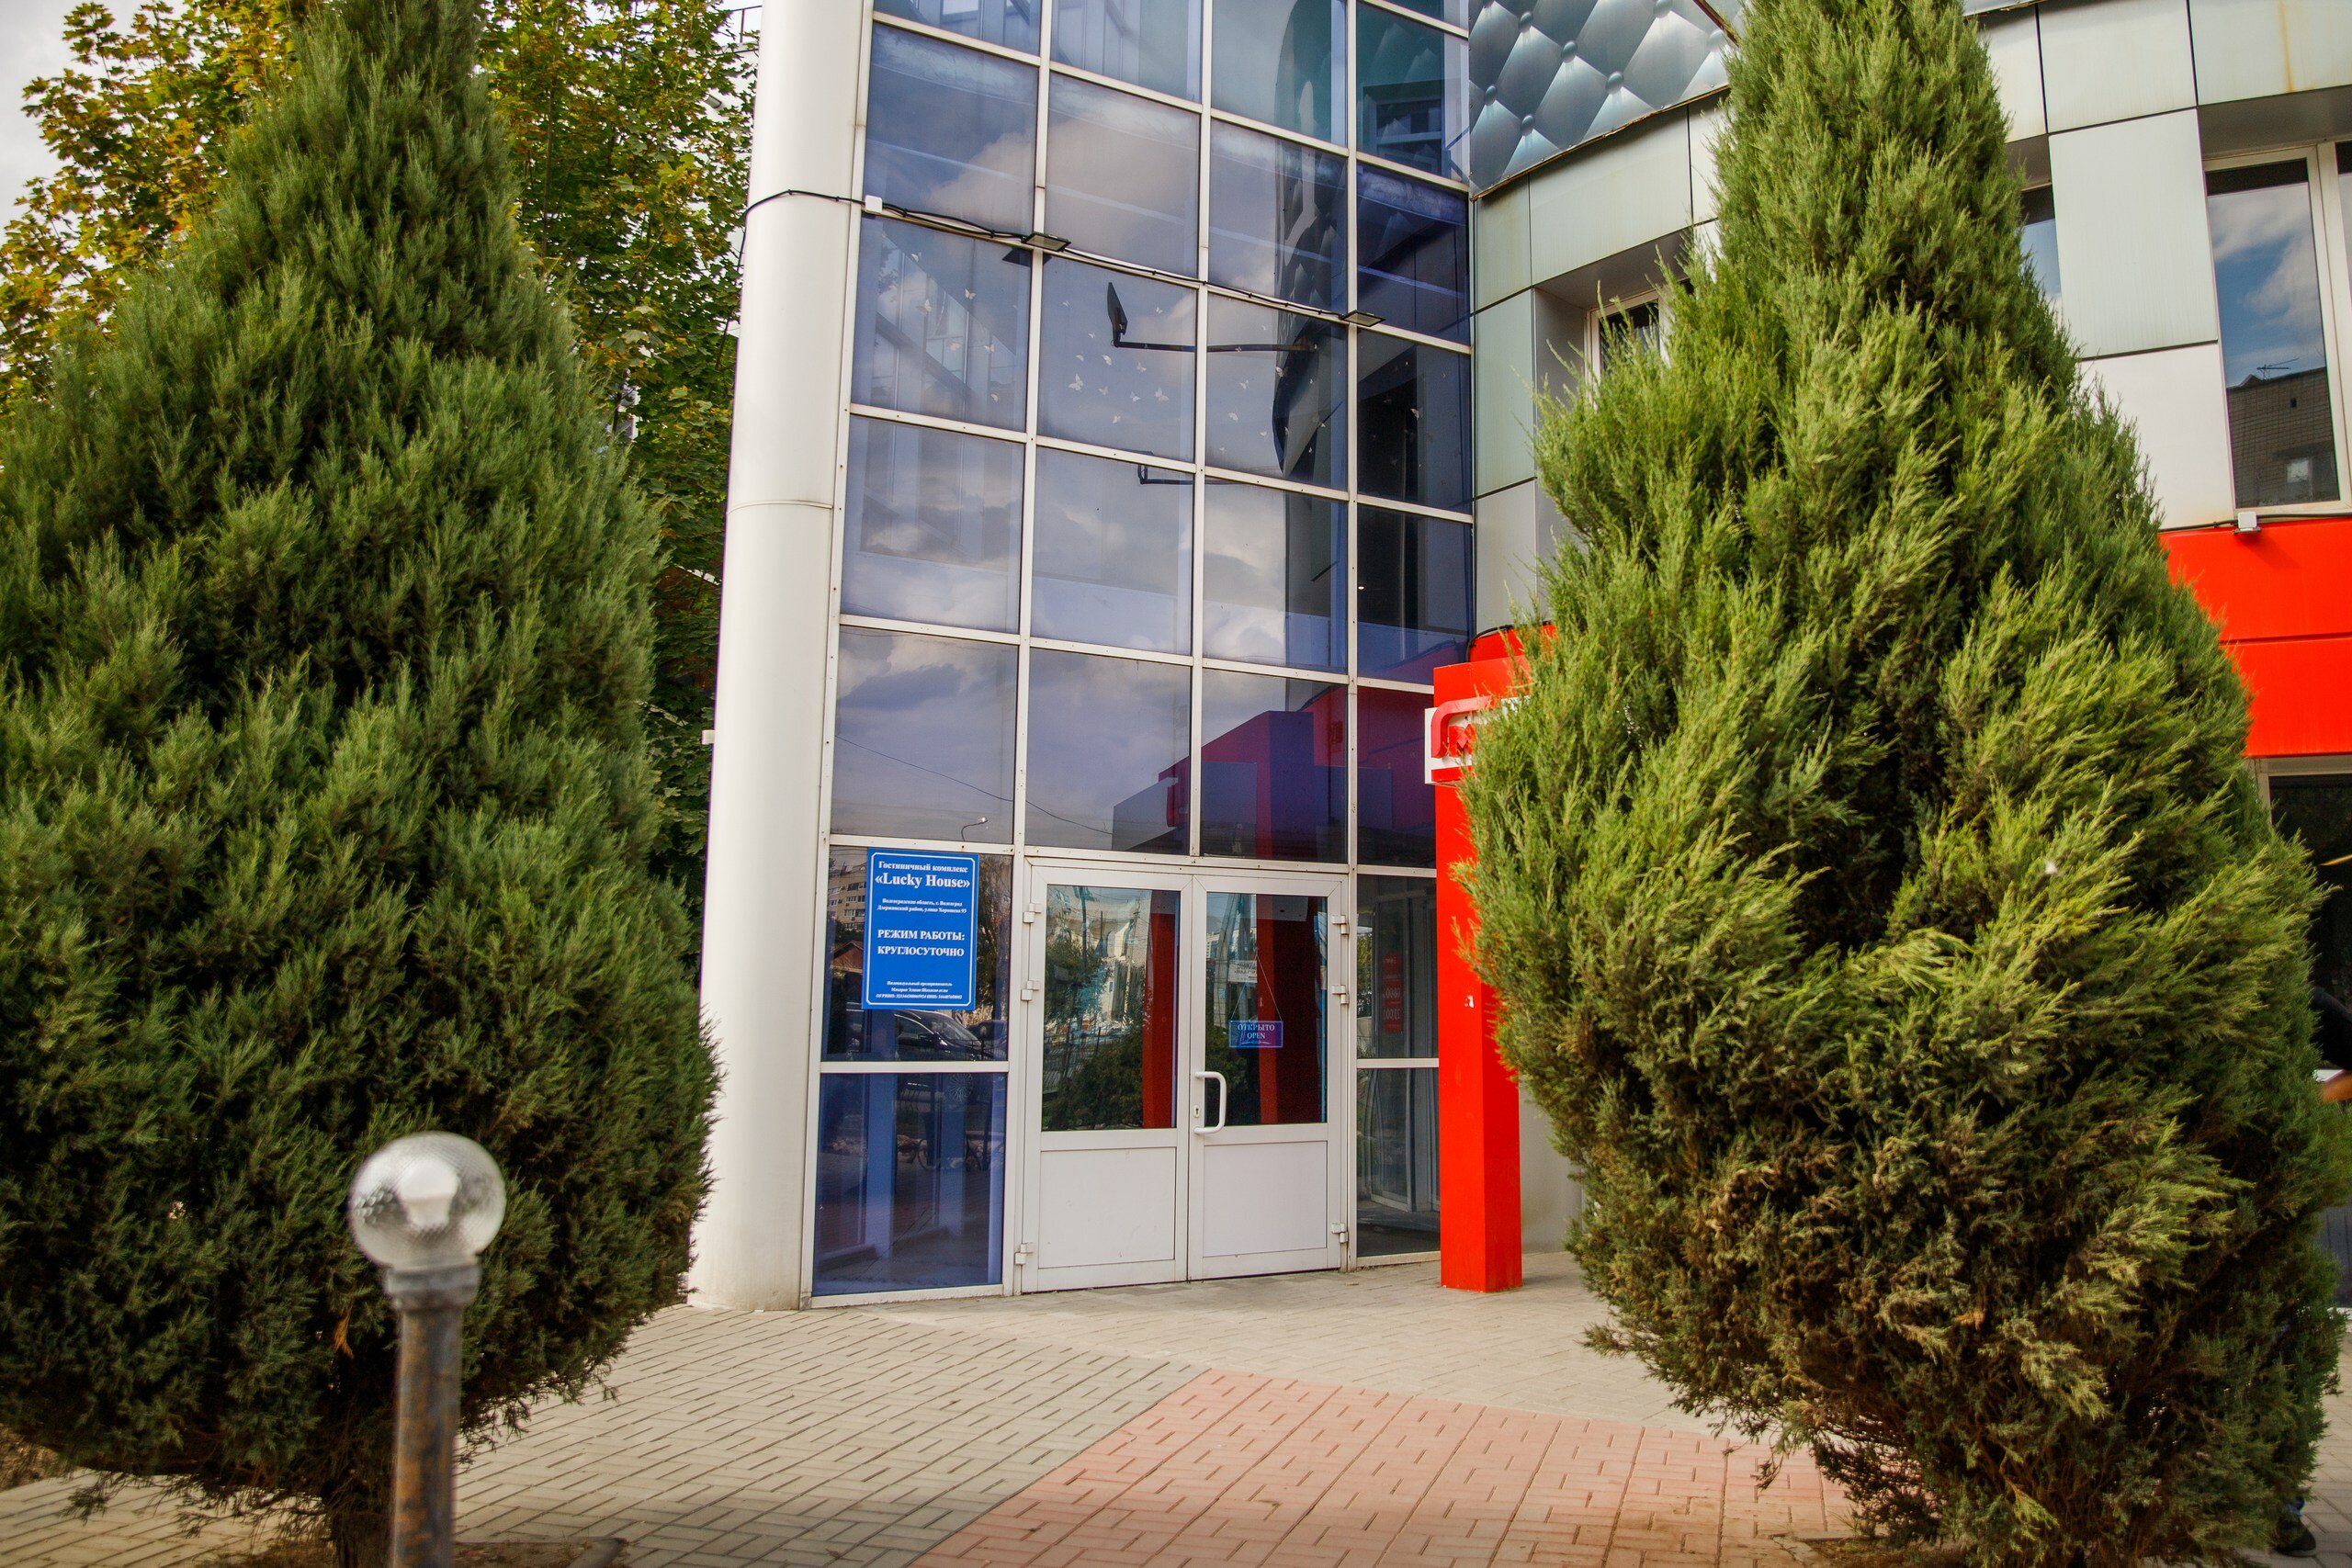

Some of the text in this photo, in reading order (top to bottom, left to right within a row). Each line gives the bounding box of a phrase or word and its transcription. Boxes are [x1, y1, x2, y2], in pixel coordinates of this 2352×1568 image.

[878, 861, 968, 873] Гостиничный комплекс
[875, 872, 970, 889] «Lucky House»
[877, 929, 966, 941] РЕЖИМ РАБОТЫ:
[877, 945, 965, 957] КРУГЛОСУТОЧНО
